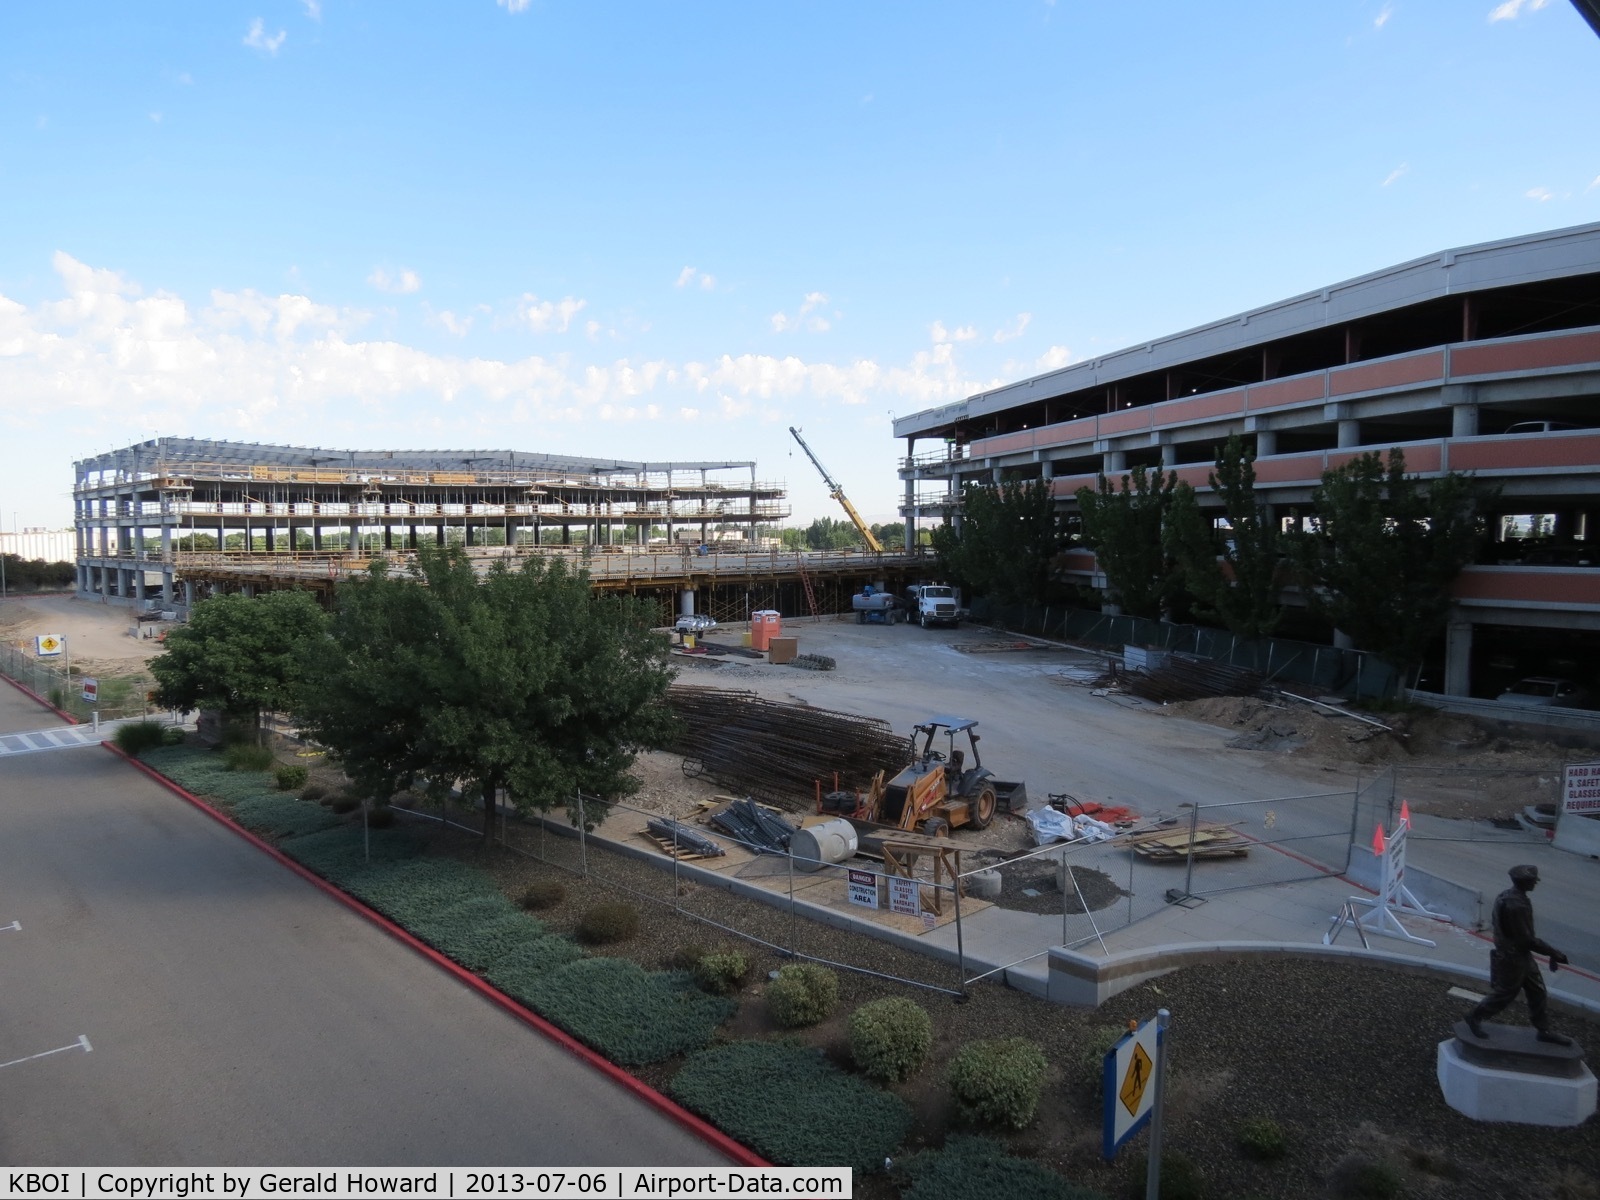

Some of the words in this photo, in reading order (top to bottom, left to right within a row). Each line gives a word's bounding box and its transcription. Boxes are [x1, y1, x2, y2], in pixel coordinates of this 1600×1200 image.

[1568, 768, 1588, 777] HARD
[1568, 780, 1573, 788] &
[852, 873, 872, 883] DANGER
[849, 884, 876, 896] CONSTRUCTION
[894, 885, 913, 894] GLASSES
[854, 894, 872, 904] AREA
[894, 905, 915, 914] REQUIRED
